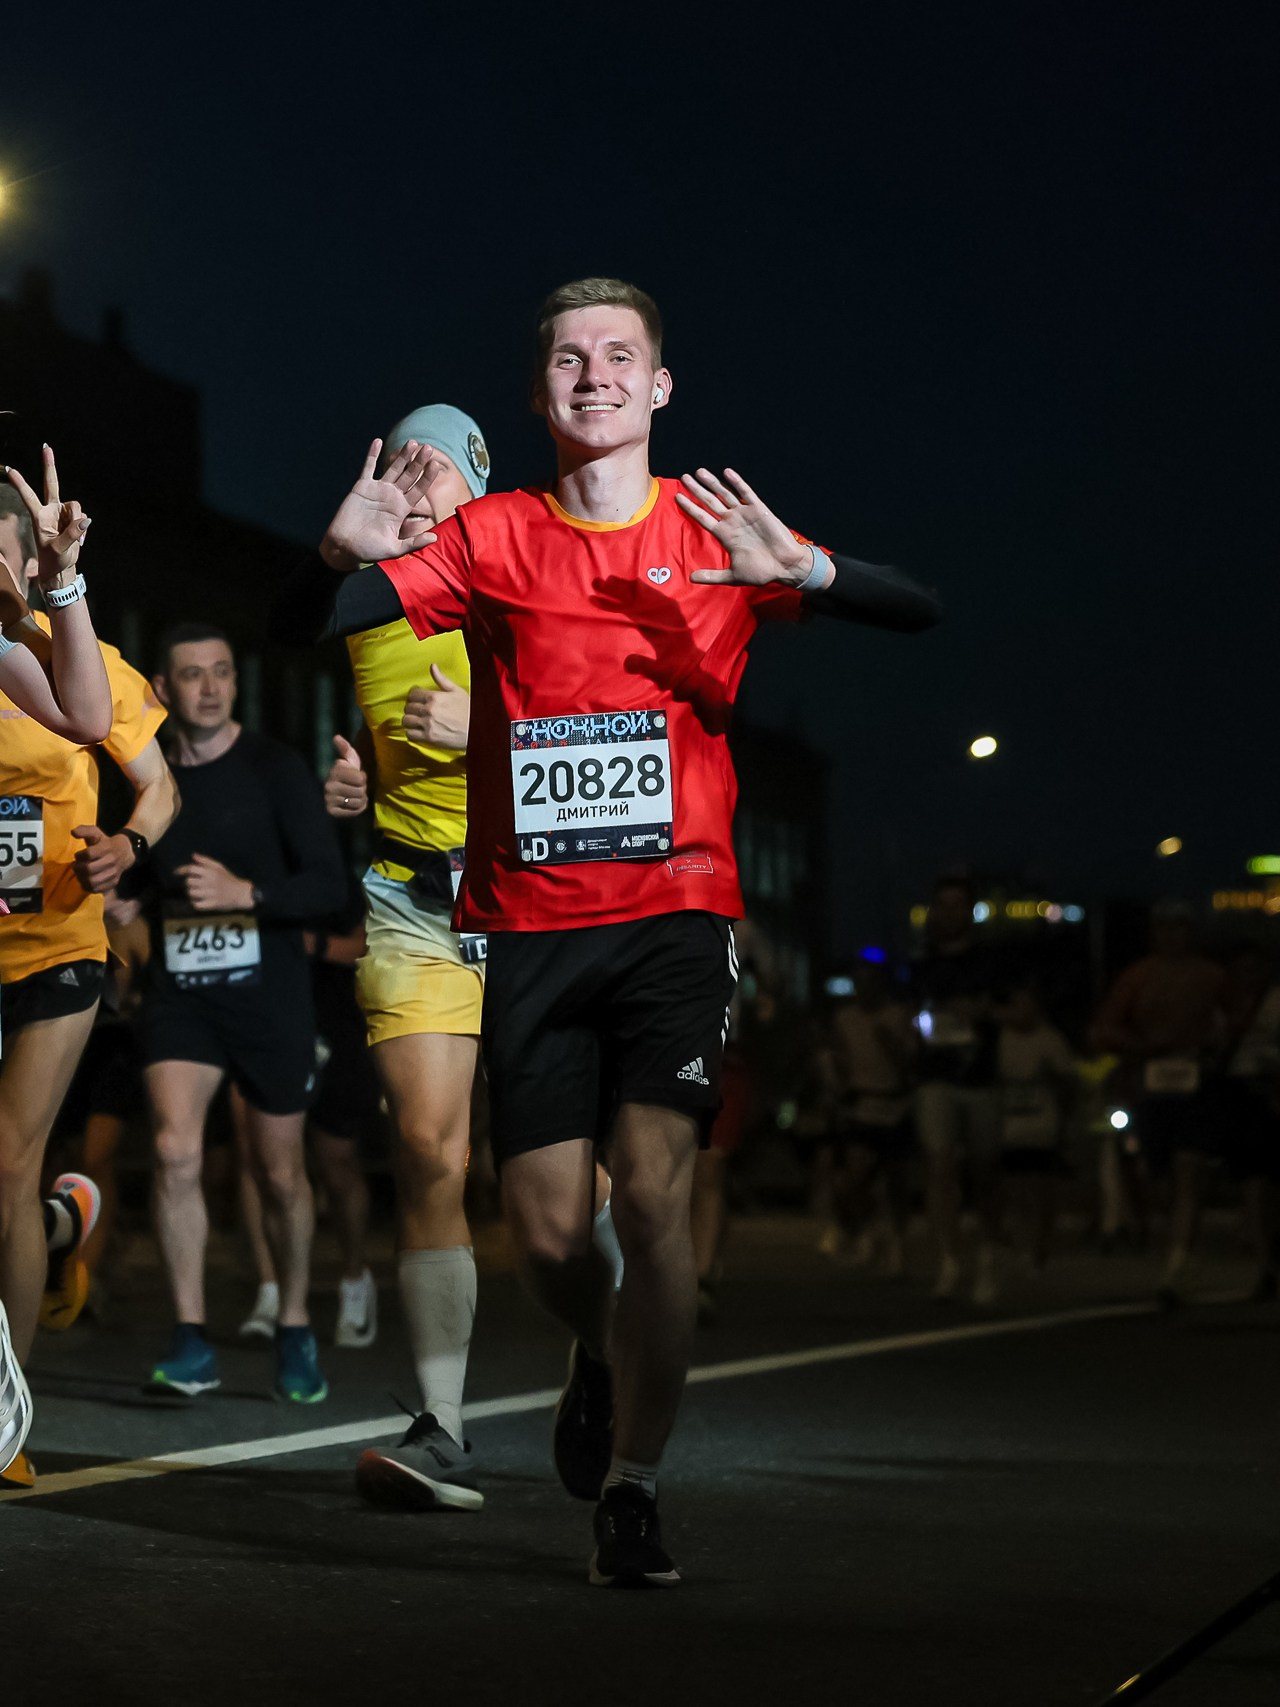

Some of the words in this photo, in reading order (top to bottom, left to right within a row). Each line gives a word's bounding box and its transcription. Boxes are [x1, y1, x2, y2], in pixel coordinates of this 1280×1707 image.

[529, 711, 650, 741] НОЧНОЙ
[519, 753, 666, 807] 20828
[556, 801, 630, 822] ДМИТРИЙ
[531, 837, 550, 862] D
[176, 923, 245, 954] 2463
[676, 1070, 710, 1086] adidas
